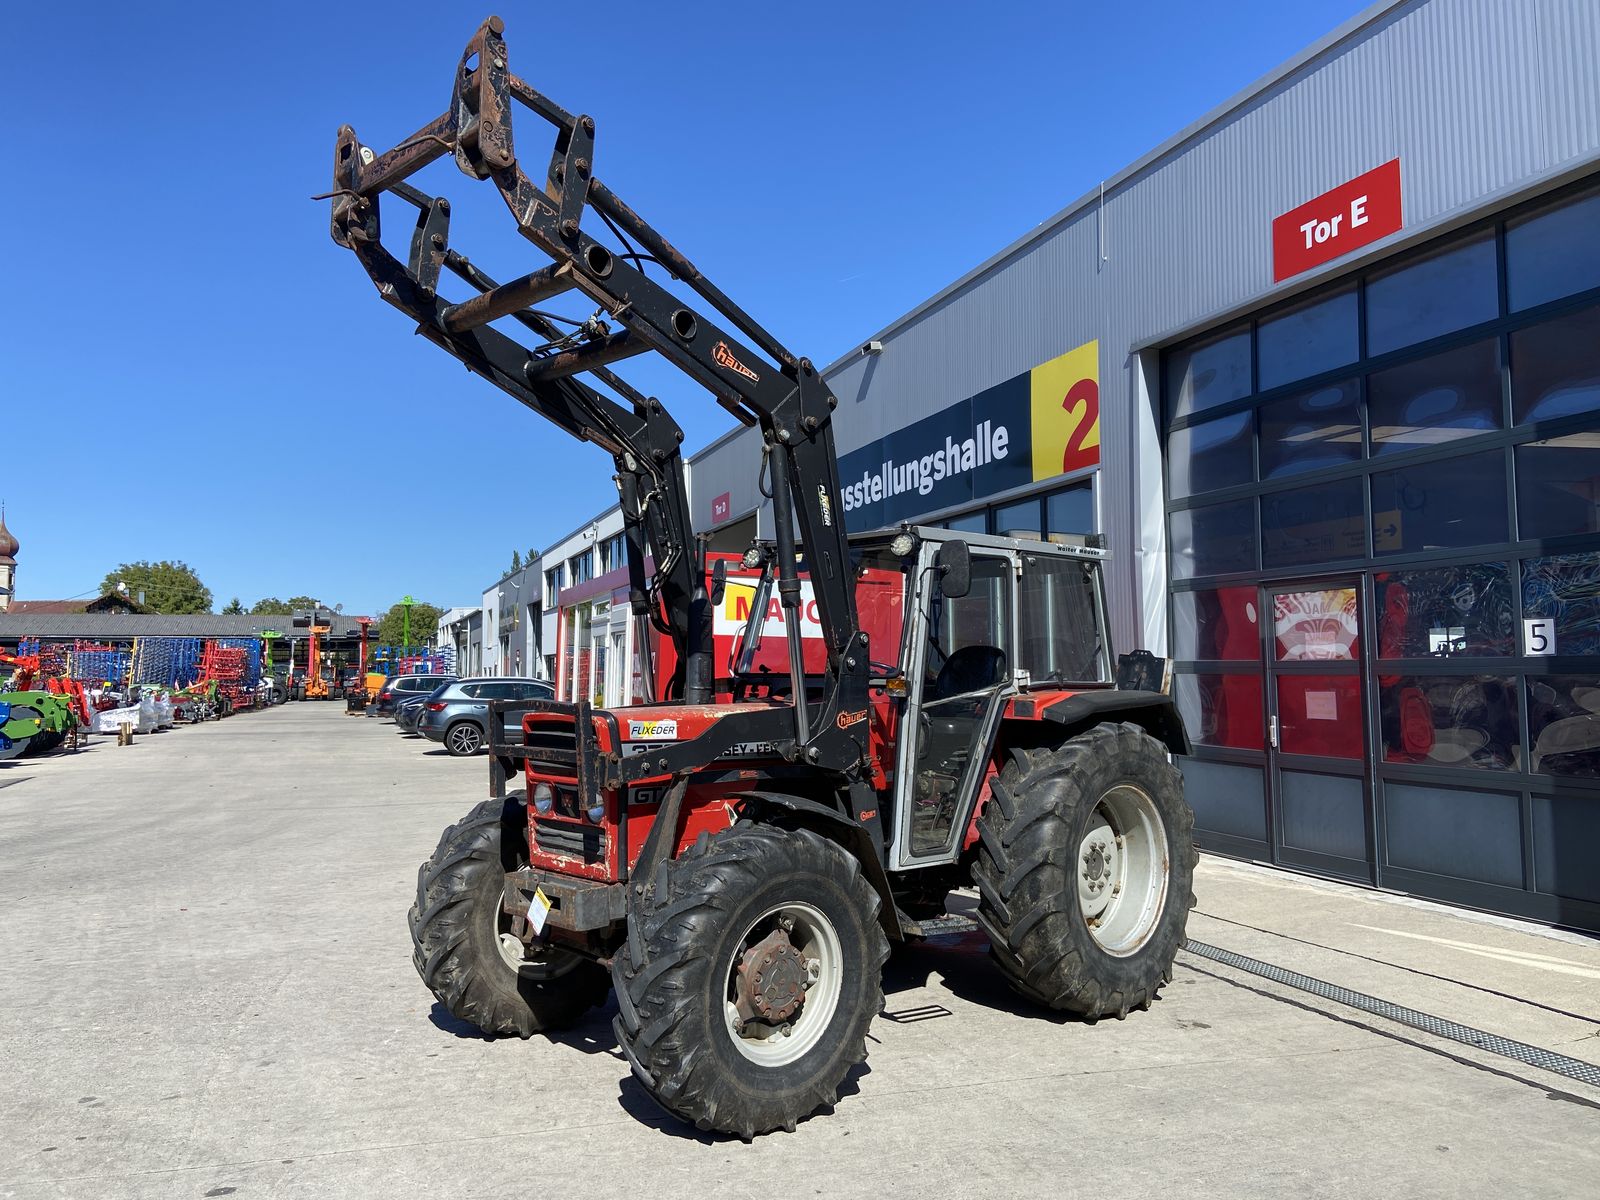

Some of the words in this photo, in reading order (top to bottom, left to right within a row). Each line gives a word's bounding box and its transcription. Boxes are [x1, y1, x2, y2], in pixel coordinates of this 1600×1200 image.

[1300, 219, 1342, 250] Tor
[1350, 195, 1368, 229] E
[1062, 378, 1100, 474] 2
[736, 596, 820, 624] MAC
[1531, 623, 1548, 652] 5
[631, 726, 675, 735] FLIXEDER
[839, 710, 867, 727] hauer
